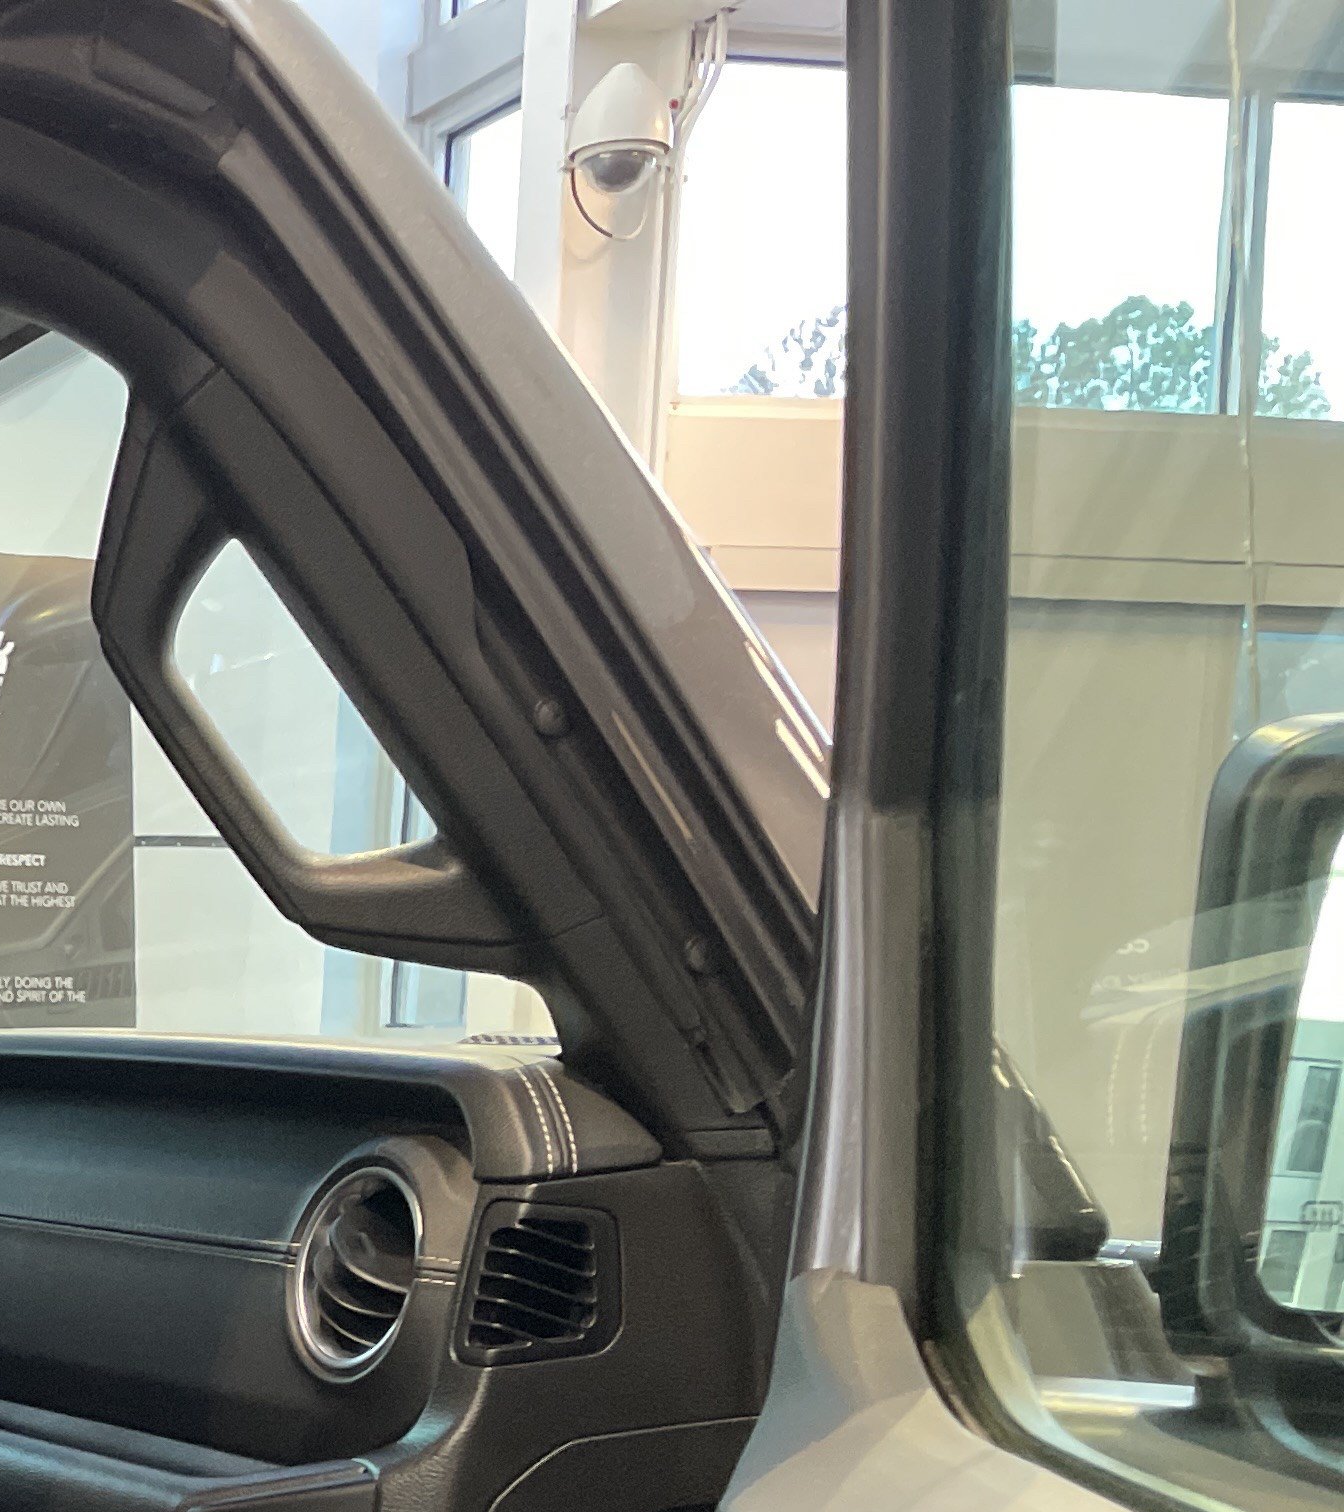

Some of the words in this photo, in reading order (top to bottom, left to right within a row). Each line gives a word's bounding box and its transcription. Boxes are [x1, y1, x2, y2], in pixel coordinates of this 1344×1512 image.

[9, 799, 35, 812] OUR
[37, 800, 66, 813] OWN
[35, 814, 80, 827] LASTING
[0, 854, 46, 867] RESPECT
[11, 880, 43, 893] TRUST
[44, 881, 69, 894] AND
[10, 894, 29, 907] THE
[31, 895, 76, 908] HIGHEST
[14, 976, 51, 989] DOING
[55, 976, 73, 989] THE
[16, 990, 46, 1003] SPIRIT
[49, 990, 64, 1003] OF
[67, 990, 86, 1003] THE
